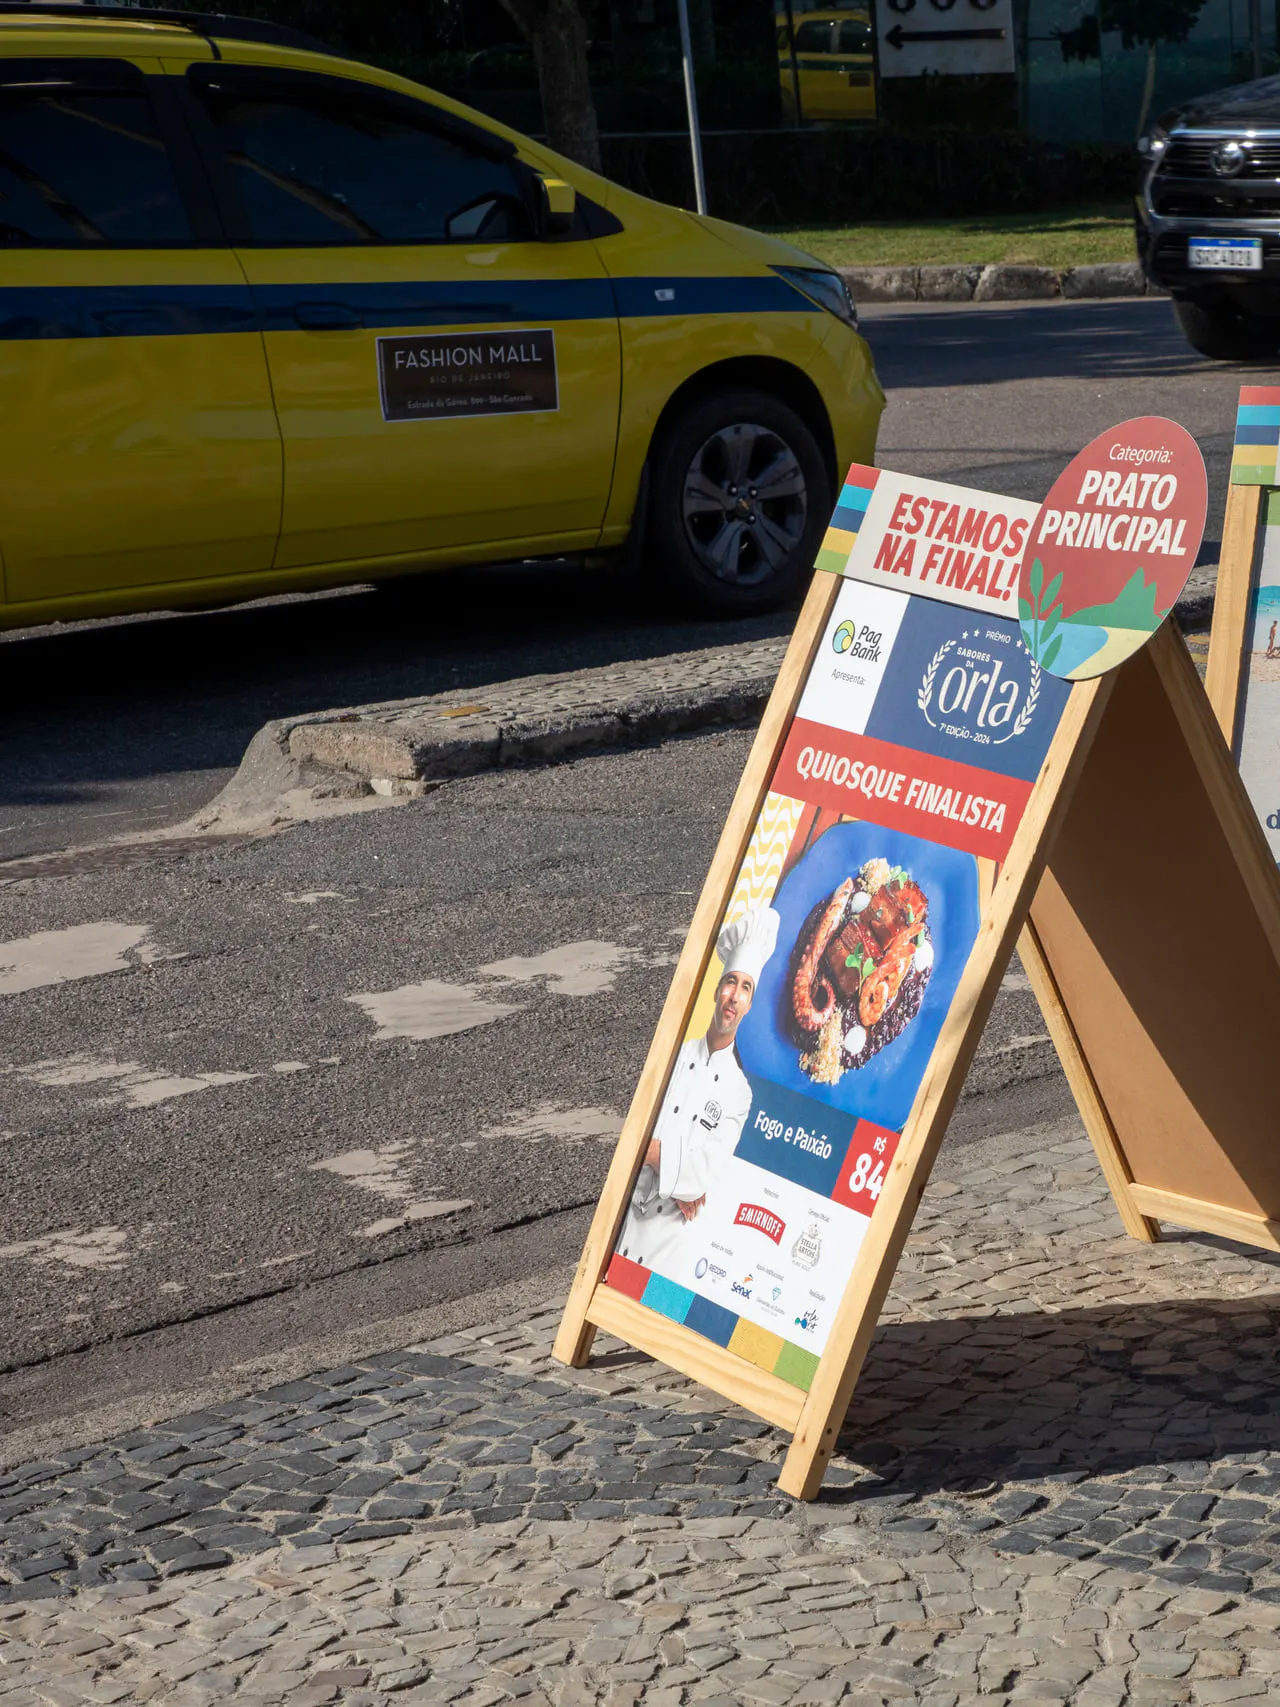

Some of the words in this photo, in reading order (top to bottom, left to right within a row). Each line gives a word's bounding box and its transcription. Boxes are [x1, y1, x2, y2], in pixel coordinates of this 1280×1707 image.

[394, 347, 482, 369] FASHION
[489, 343, 543, 364] MALL
[1109, 443, 1174, 466] Categoria:
[1077, 470, 1178, 511] PRATO
[888, 493, 1029, 557] ESTAMOS
[1037, 509, 1187, 556] PRINCIPAL
[873, 533, 915, 578] NA
[919, 548, 1021, 602] FINAL!
[857, 625, 883, 649] Pag
[985, 630, 1011, 644] PRÊMIO
[850, 642, 882, 663] Bank
[956, 647, 991, 663] SABORES
[965, 660, 974, 668] DA
[831, 668, 866, 687] Apresenta:
[938, 660, 1019, 727] orla
[945, 724, 971, 740] EDIÇÃO
[973, 732, 991, 744] 2024
[796, 745, 906, 801] QUIOSQUE
[904, 778, 1007, 833] FINALISTA
[754, 1110, 783, 1141] Fogo
[784, 1128, 794, 1142] e
[793, 1126, 832, 1160] Paixão
[873, 1136, 887, 1155] R$
[849, 1153, 885, 1200] 84
[738, 1206, 783, 1237] SMIRNOFF
[798, 1246, 816, 1259] ARTOIS
[800, 1238, 818, 1252] STELLA
[708, 1263, 727, 1278] RECORD
